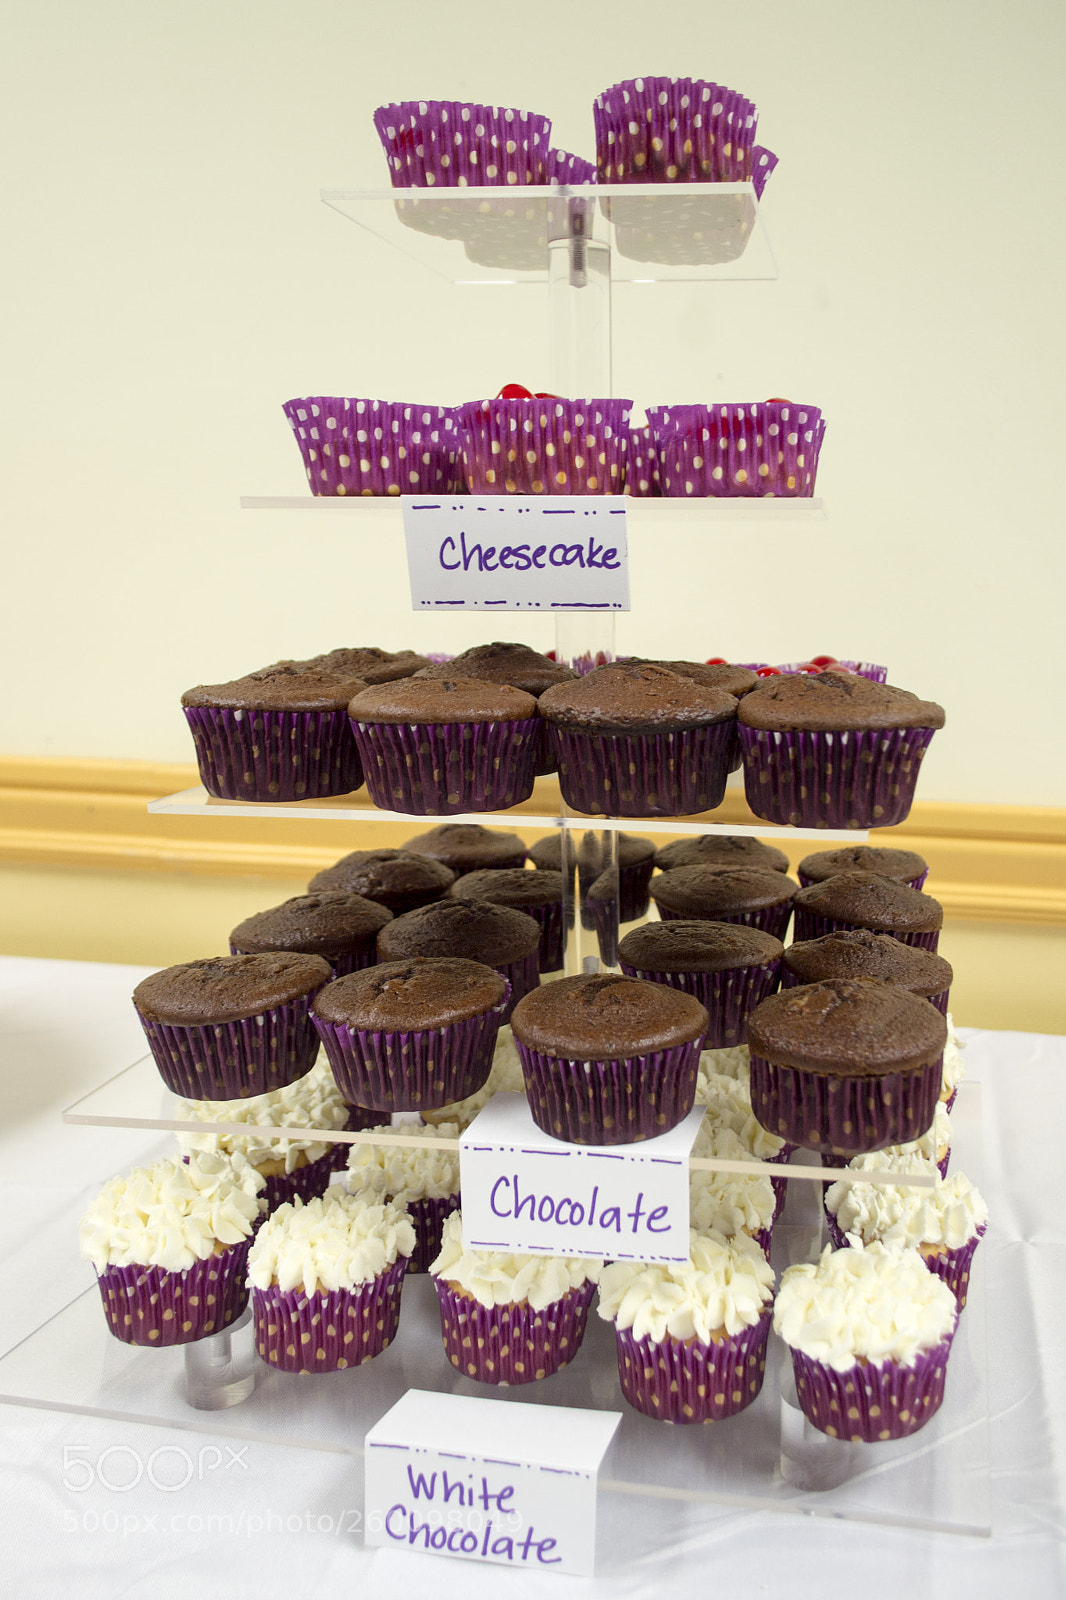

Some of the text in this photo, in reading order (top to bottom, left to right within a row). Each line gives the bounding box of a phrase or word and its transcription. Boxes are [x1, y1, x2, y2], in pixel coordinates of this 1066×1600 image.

[439, 531, 621, 572] Cheesecake
[490, 1174, 672, 1233] Chocolate
[407, 1464, 515, 1513] White
[385, 1503, 562, 1564] Chocolate
